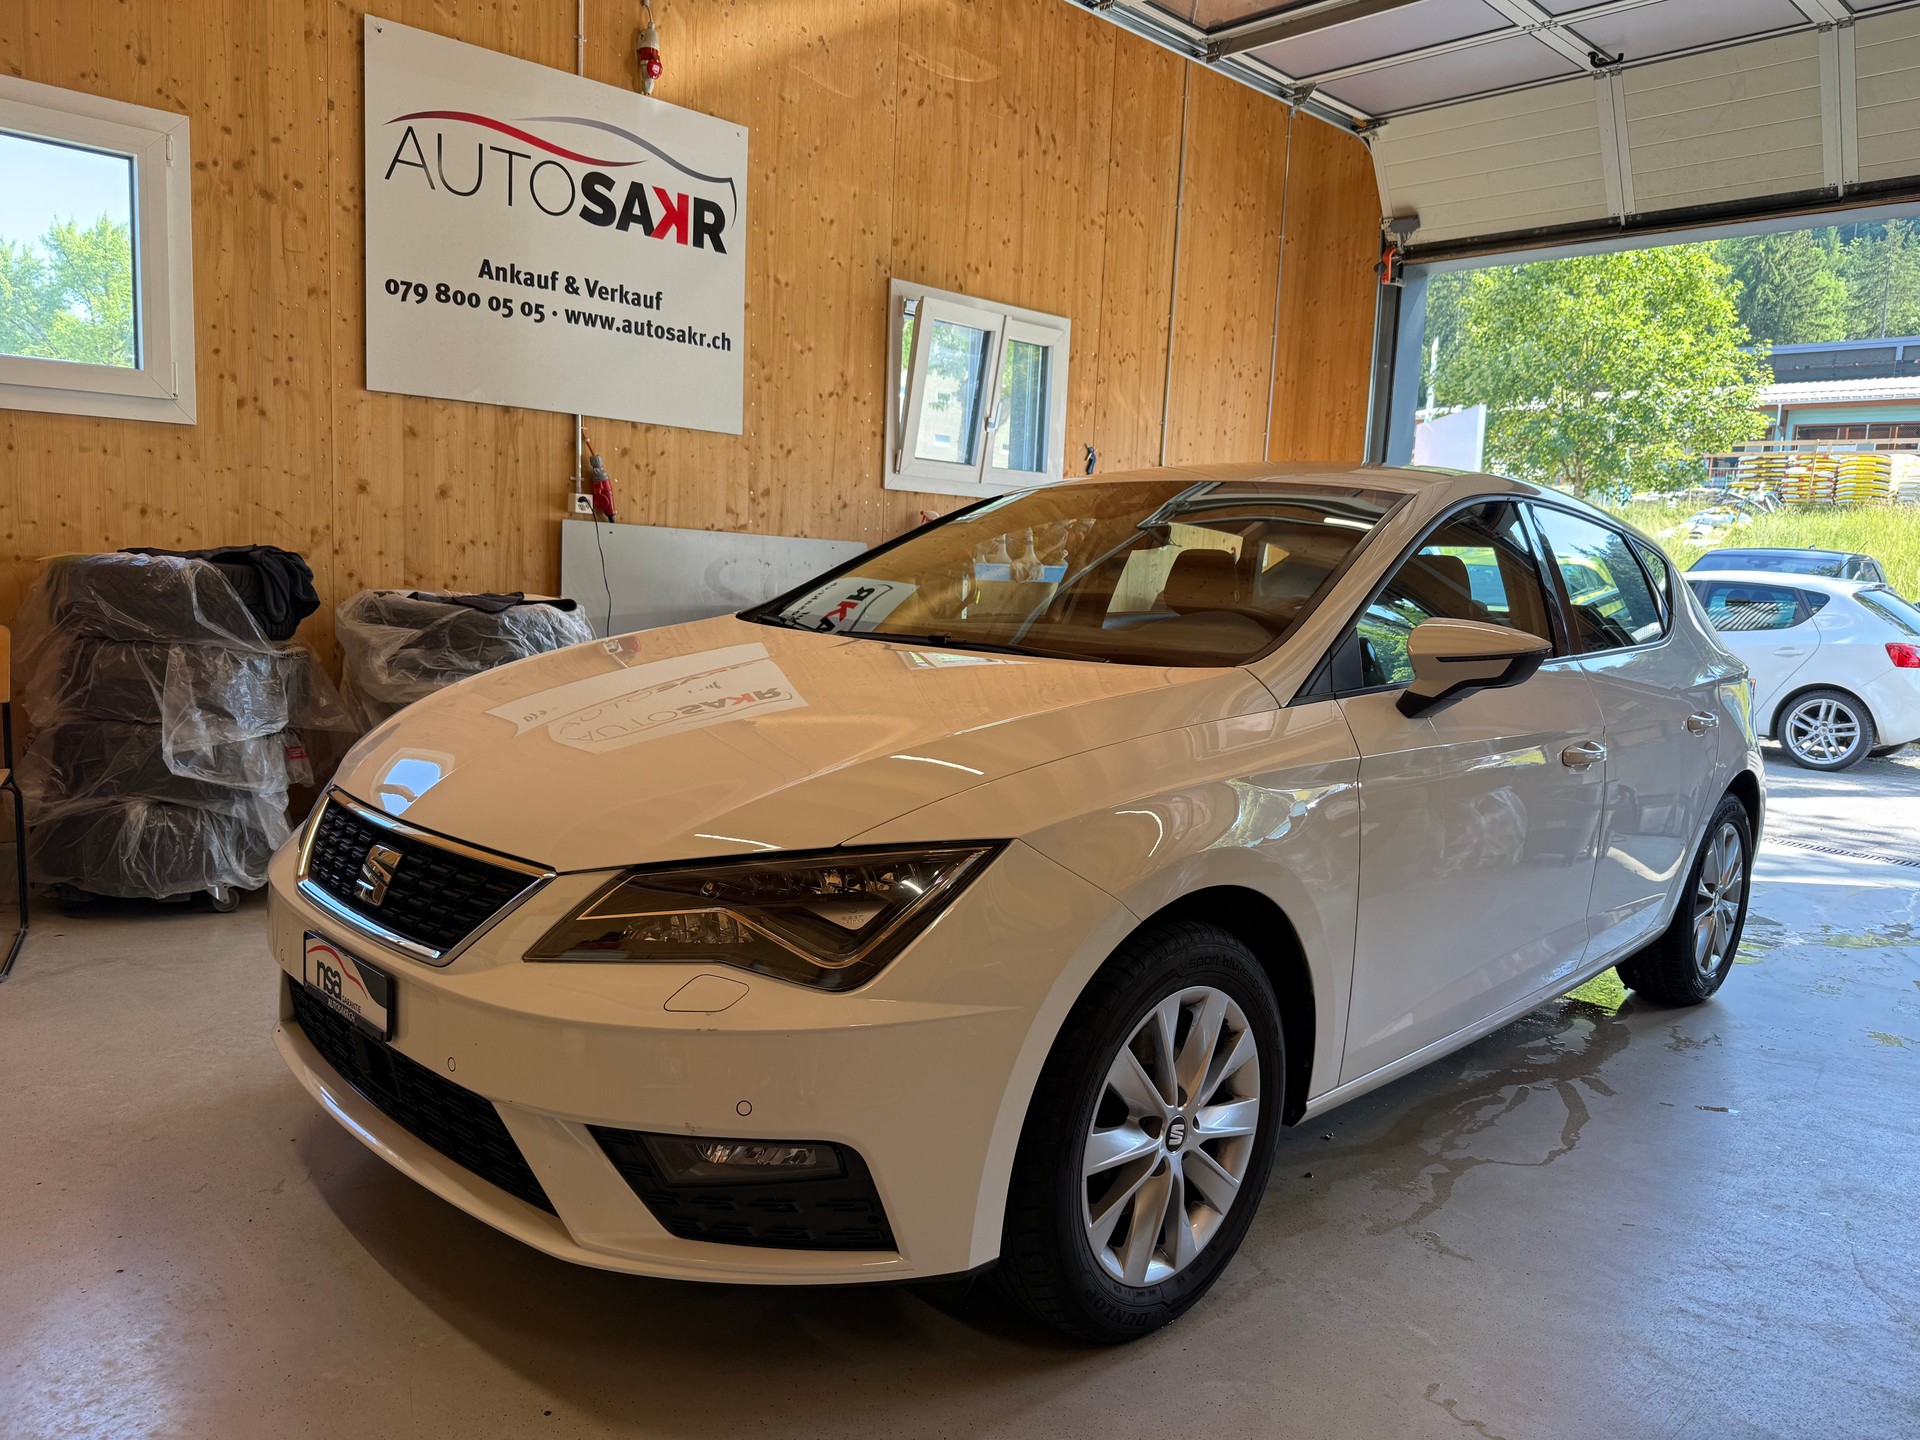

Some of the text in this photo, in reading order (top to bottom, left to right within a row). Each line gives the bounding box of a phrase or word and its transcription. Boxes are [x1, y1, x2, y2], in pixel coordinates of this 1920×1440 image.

[478, 258, 663, 311] Ankauf & Verkauf
[385, 278, 428, 304] 079
[435, 283, 481, 308] 800
[488, 296, 514, 318] 05
[520, 301, 545, 324] 05
[564, 308, 731, 351] www.autosakr.ch
[316, 959, 342, 1000] nsa
